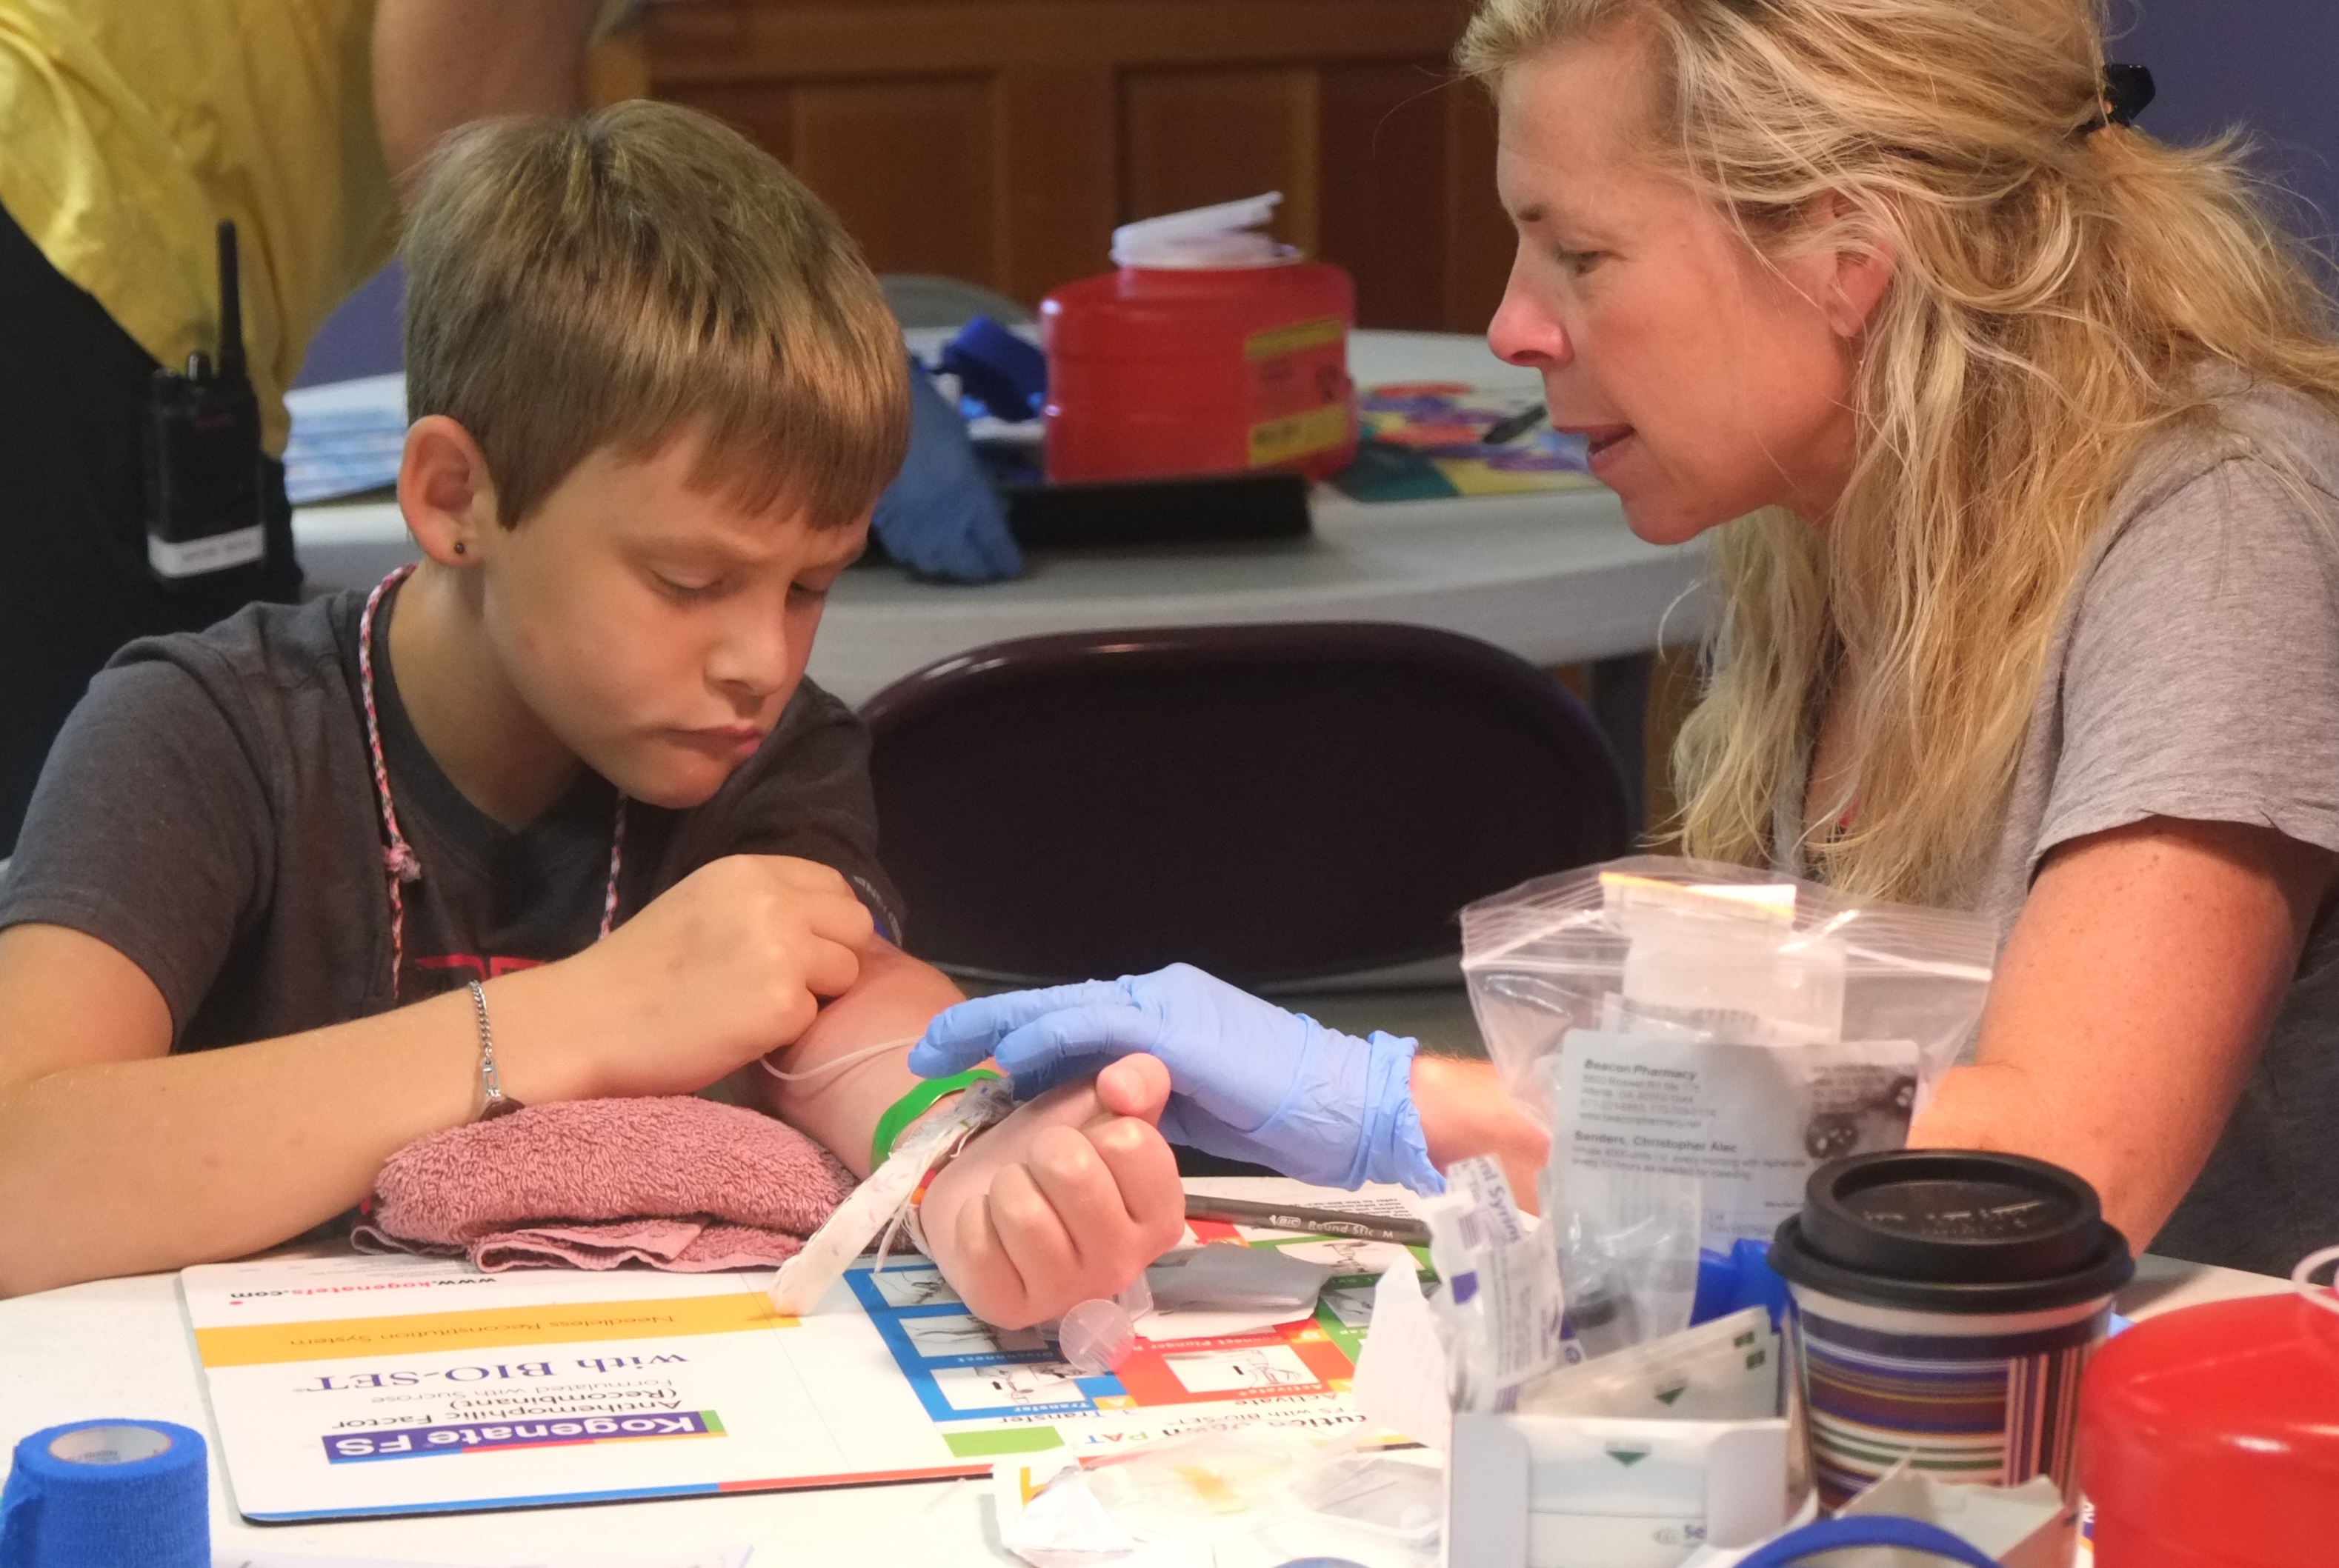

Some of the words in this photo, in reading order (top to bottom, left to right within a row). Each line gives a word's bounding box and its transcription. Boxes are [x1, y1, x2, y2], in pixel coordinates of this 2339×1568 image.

[1584, 1059, 1631, 1073] Beacon
[1634, 1064, 1697, 1081] Pharmacy
[1632, 1135, 1707, 1151] Christopher
[1278, 1217, 1300, 1227] BIC
[1308, 1220, 1348, 1233] Round
[1352, 1225, 1374, 1236] Stic
[1383, 1230, 1394, 1238] M
[231, 1278, 497, 1298] www.kogenatefs.com
[550, 1315, 673, 1327] Needleless
[290, 1334, 372, 1345] System
[381, 1324, 541, 1340] Reconstitution
[575, 1354, 689, 1373] with
[475, 1387, 525, 1396] with
[536, 1378, 673, 1394] Formulated
[371, 1392, 466, 1404] Sucrose
[450, 1388, 677, 1409] (Recombinant)
[445, 1400, 682, 1421] Antihemophilic
[1014, 1402, 1089, 1412] Transfer
[1268, 1409, 1311, 1418] with
[331, 1414, 432, 1429] Factor
[999, 1411, 1107, 1423] Transfer
[336, 1434, 413, 1456] FS
[1085, 1431, 1149, 1444] PAT
